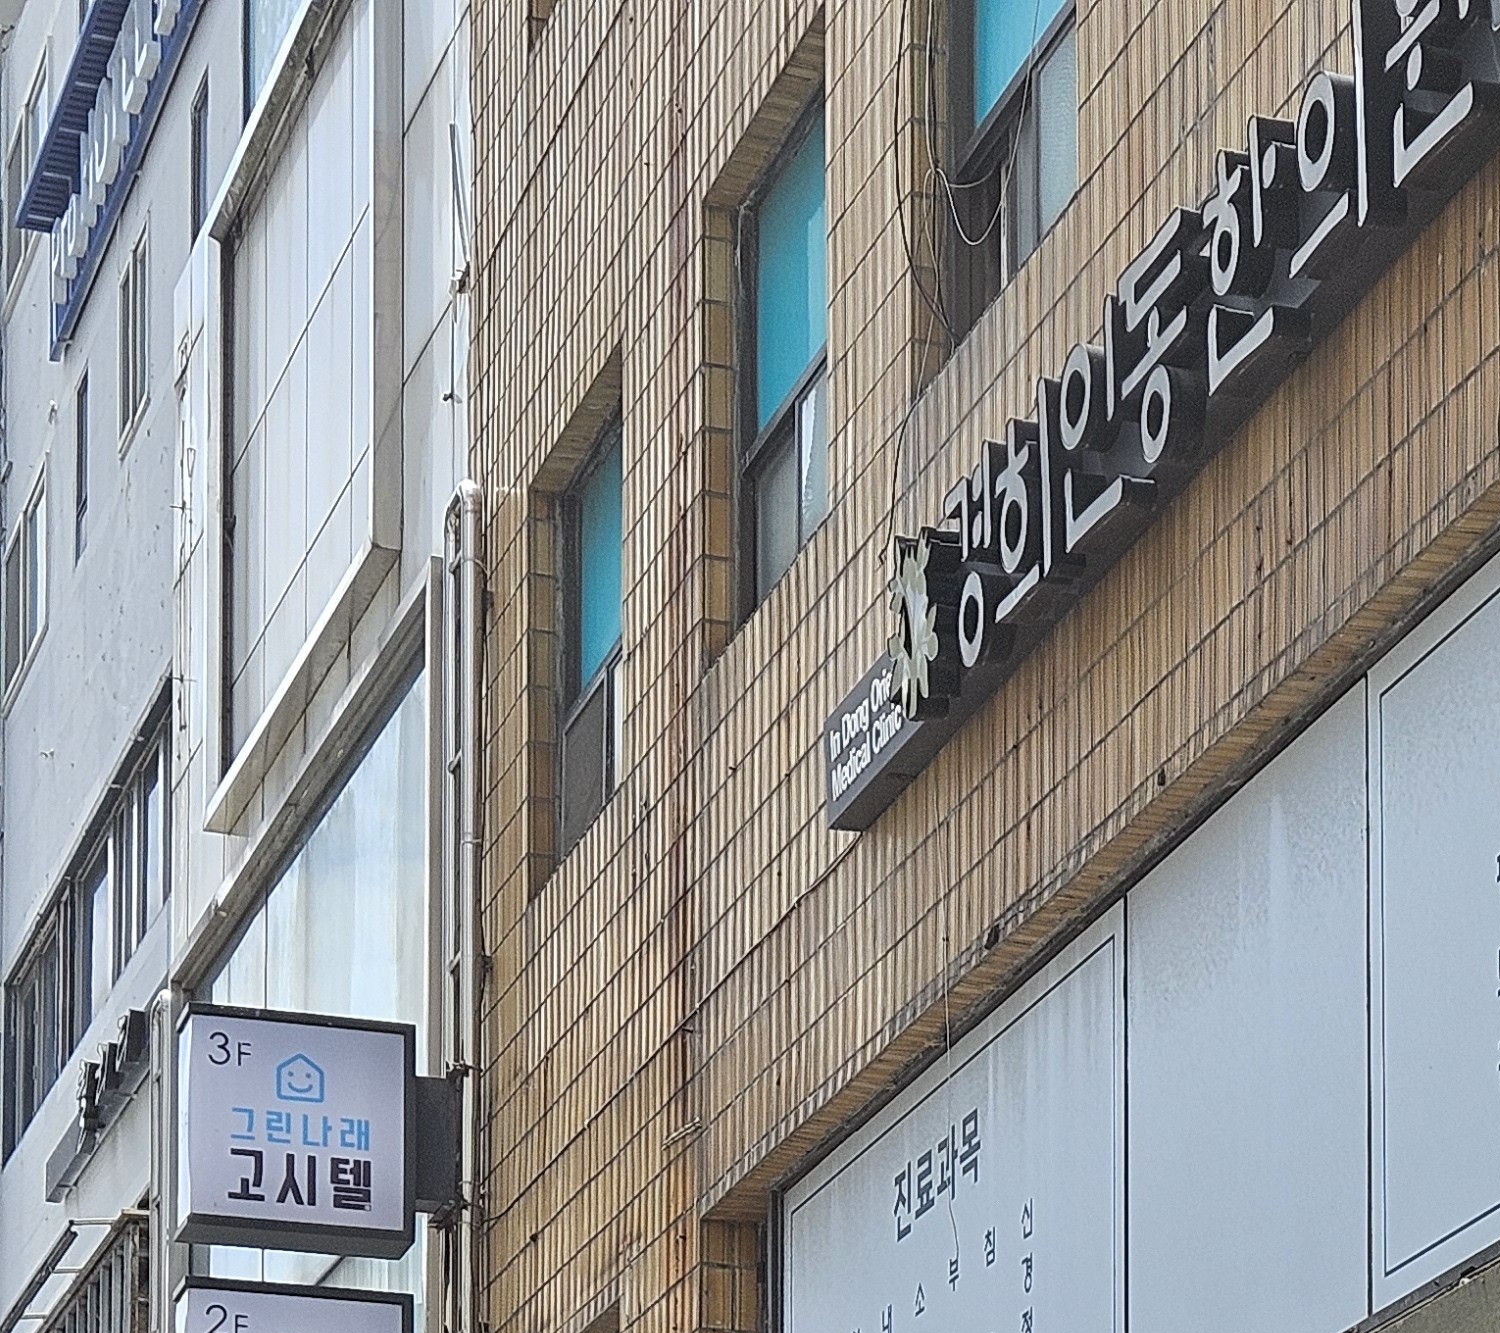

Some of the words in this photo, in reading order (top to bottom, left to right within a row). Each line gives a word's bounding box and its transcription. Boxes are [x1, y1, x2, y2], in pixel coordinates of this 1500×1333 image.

[829, 729, 841, 763] In
[841, 698, 870, 749] Dong
[831, 731, 872, 802] Medical
[872, 703, 902, 755] Clinic
[207, 1031, 252, 1067] 3F
[230, 1107, 370, 1152] 그린나래
[227, 1148, 373, 1212] 고시텔
[893, 1107, 982, 1243] 진료과목
